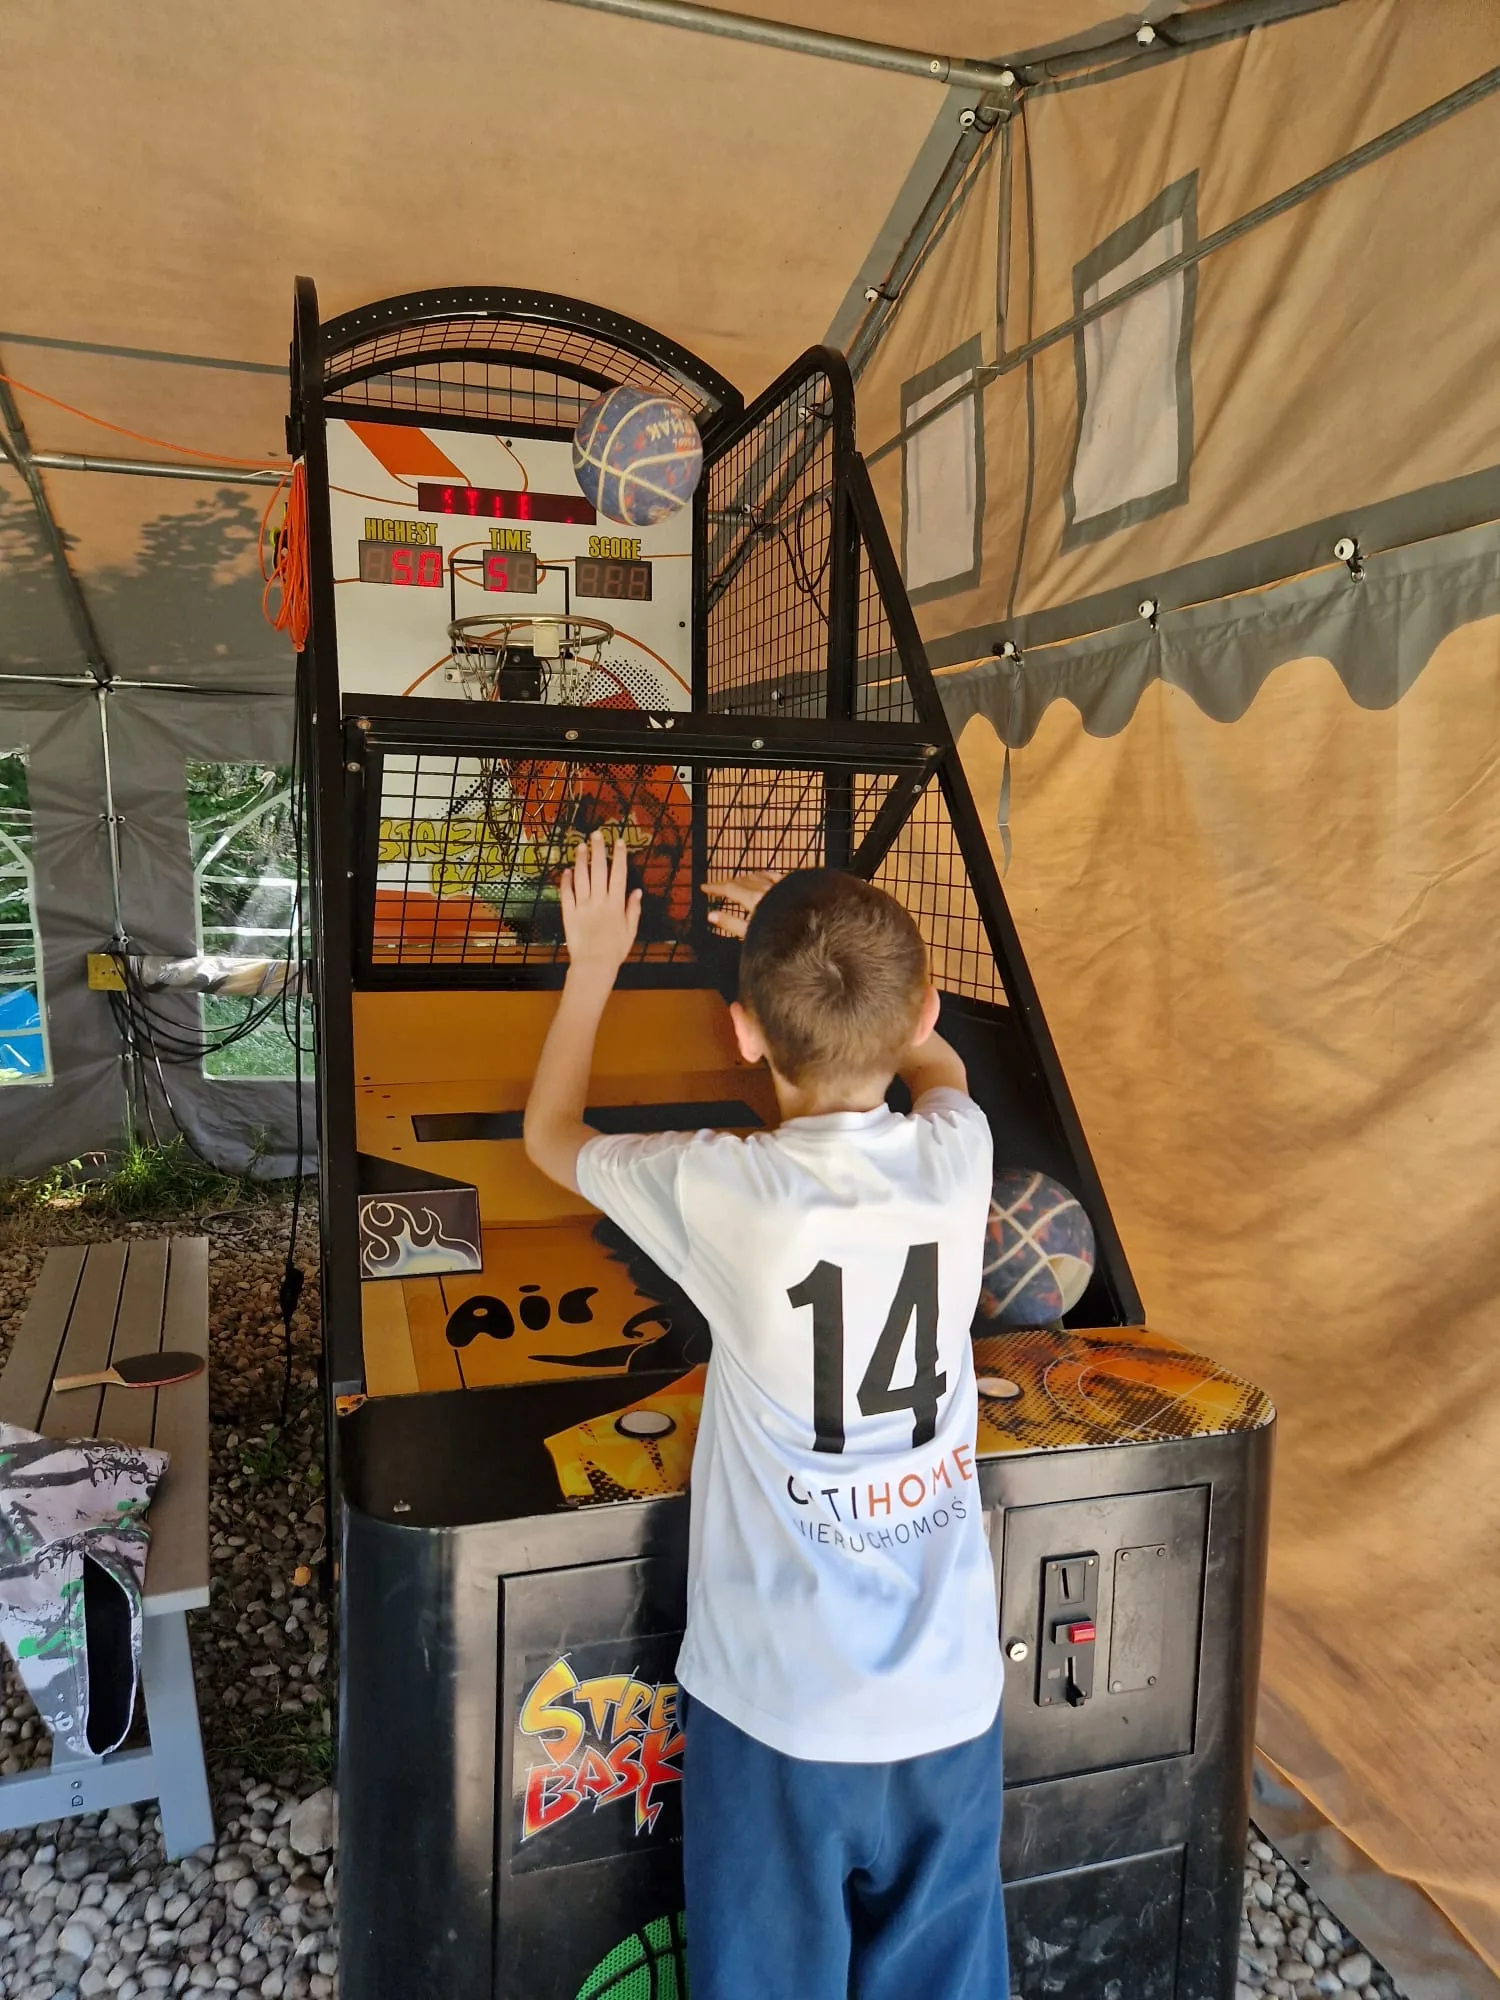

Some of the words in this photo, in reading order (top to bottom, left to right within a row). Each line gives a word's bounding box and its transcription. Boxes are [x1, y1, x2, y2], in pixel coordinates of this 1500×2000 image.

[365, 517, 438, 545] HIGHEST
[489, 528, 532, 552] TIME
[589, 535, 642, 560] SCORE
[391, 549, 440, 588] 50
[786, 1241, 947, 1455] 14
